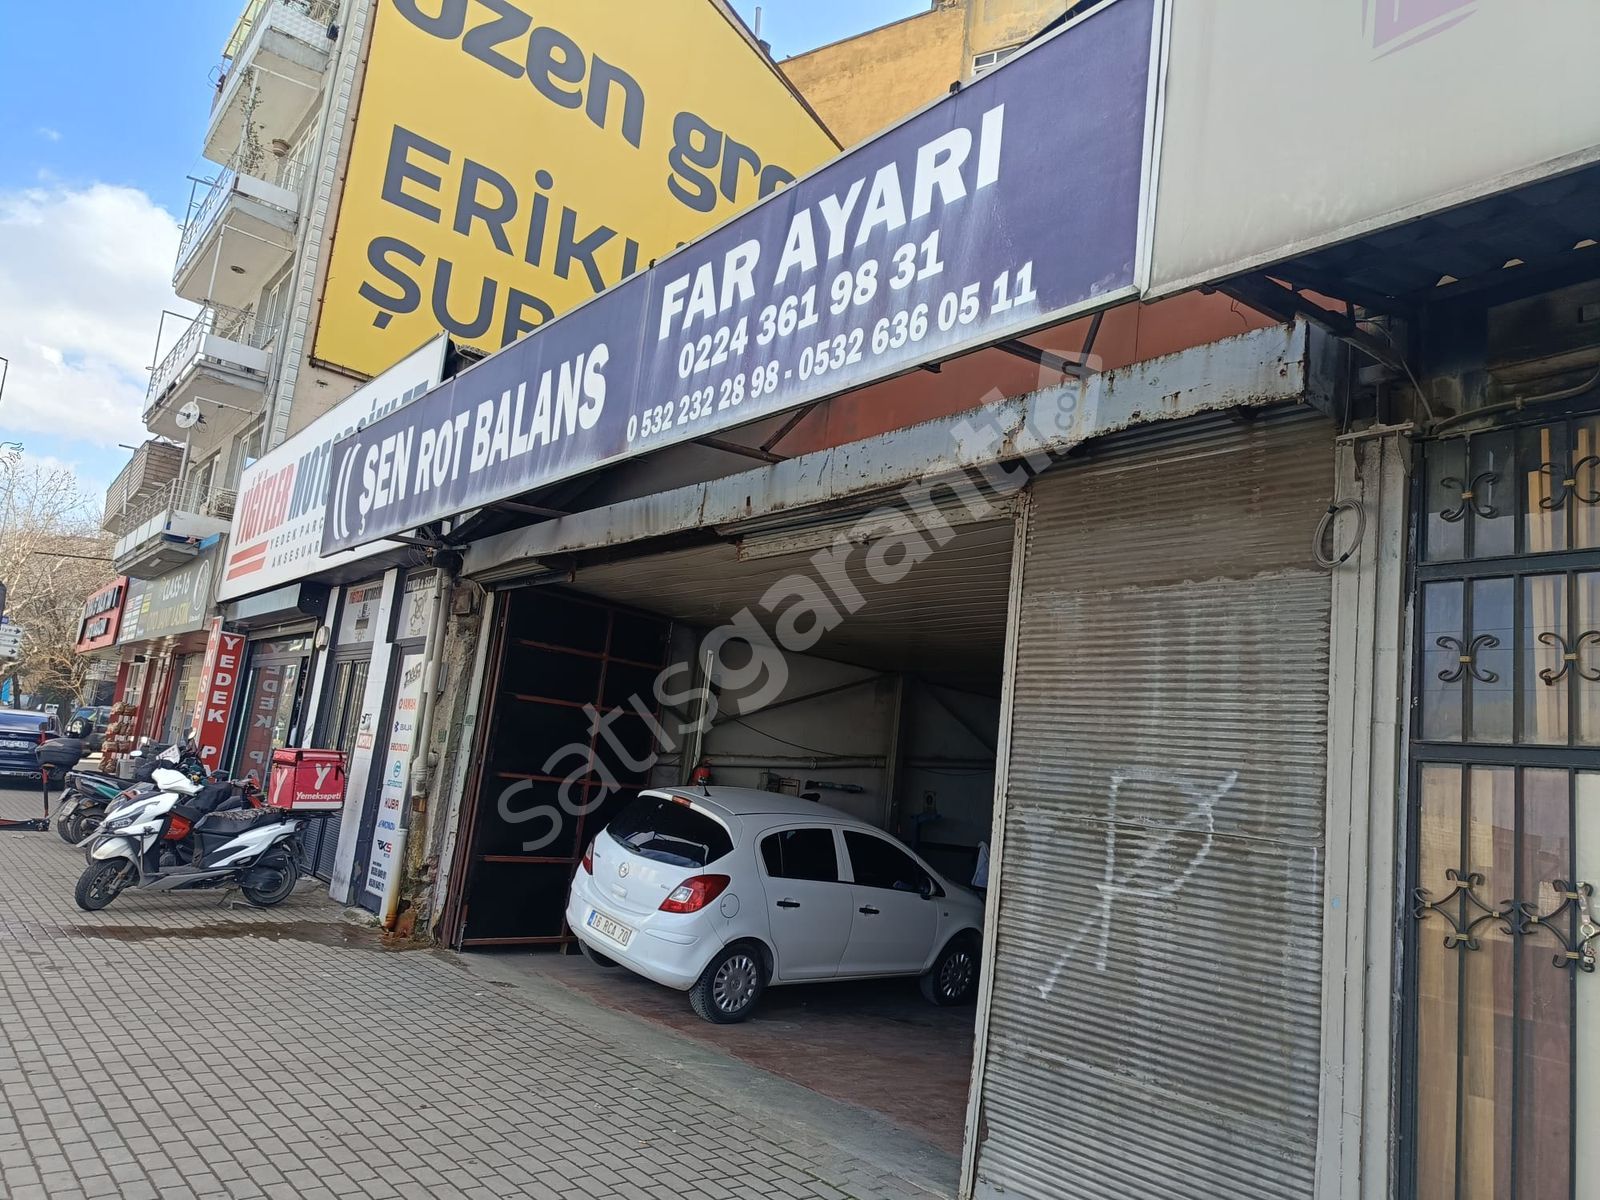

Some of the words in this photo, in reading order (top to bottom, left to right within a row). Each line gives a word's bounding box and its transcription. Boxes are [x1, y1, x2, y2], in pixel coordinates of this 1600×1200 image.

[658, 239, 761, 341] FAR
[774, 103, 1005, 286] AYARI
[626, 413, 639, 443] 0
[640, 399, 673, 436] 532
[675, 384, 714, 427] 232
[718, 373, 748, 408] 28
[750, 363, 779, 400] 98
[798, 328, 864, 382] 0532
[871, 302, 929, 357] 636
[937, 281, 980, 332] 05
[990, 260, 1038, 315] 11
[678, 325, 748, 380] 0224
[756, 283, 819, 347] 361
[830, 258, 878, 314] 98
[889, 229, 945, 291] 31
[359, 425, 415, 537] ŞEN
[414, 410, 471, 496] ROT
[469, 343, 610, 475] BALANS
[270, 527, 299, 551] YEDEK
[299, 515, 324, 538] PARÇ
[206, 635, 240, 724] YEDEK
[296, 790, 342, 803] Yemeksepeti
[592, 914, 601, 929] 16
[602, 918, 617, 939] RCA
[617, 928, 628, 943] 70
